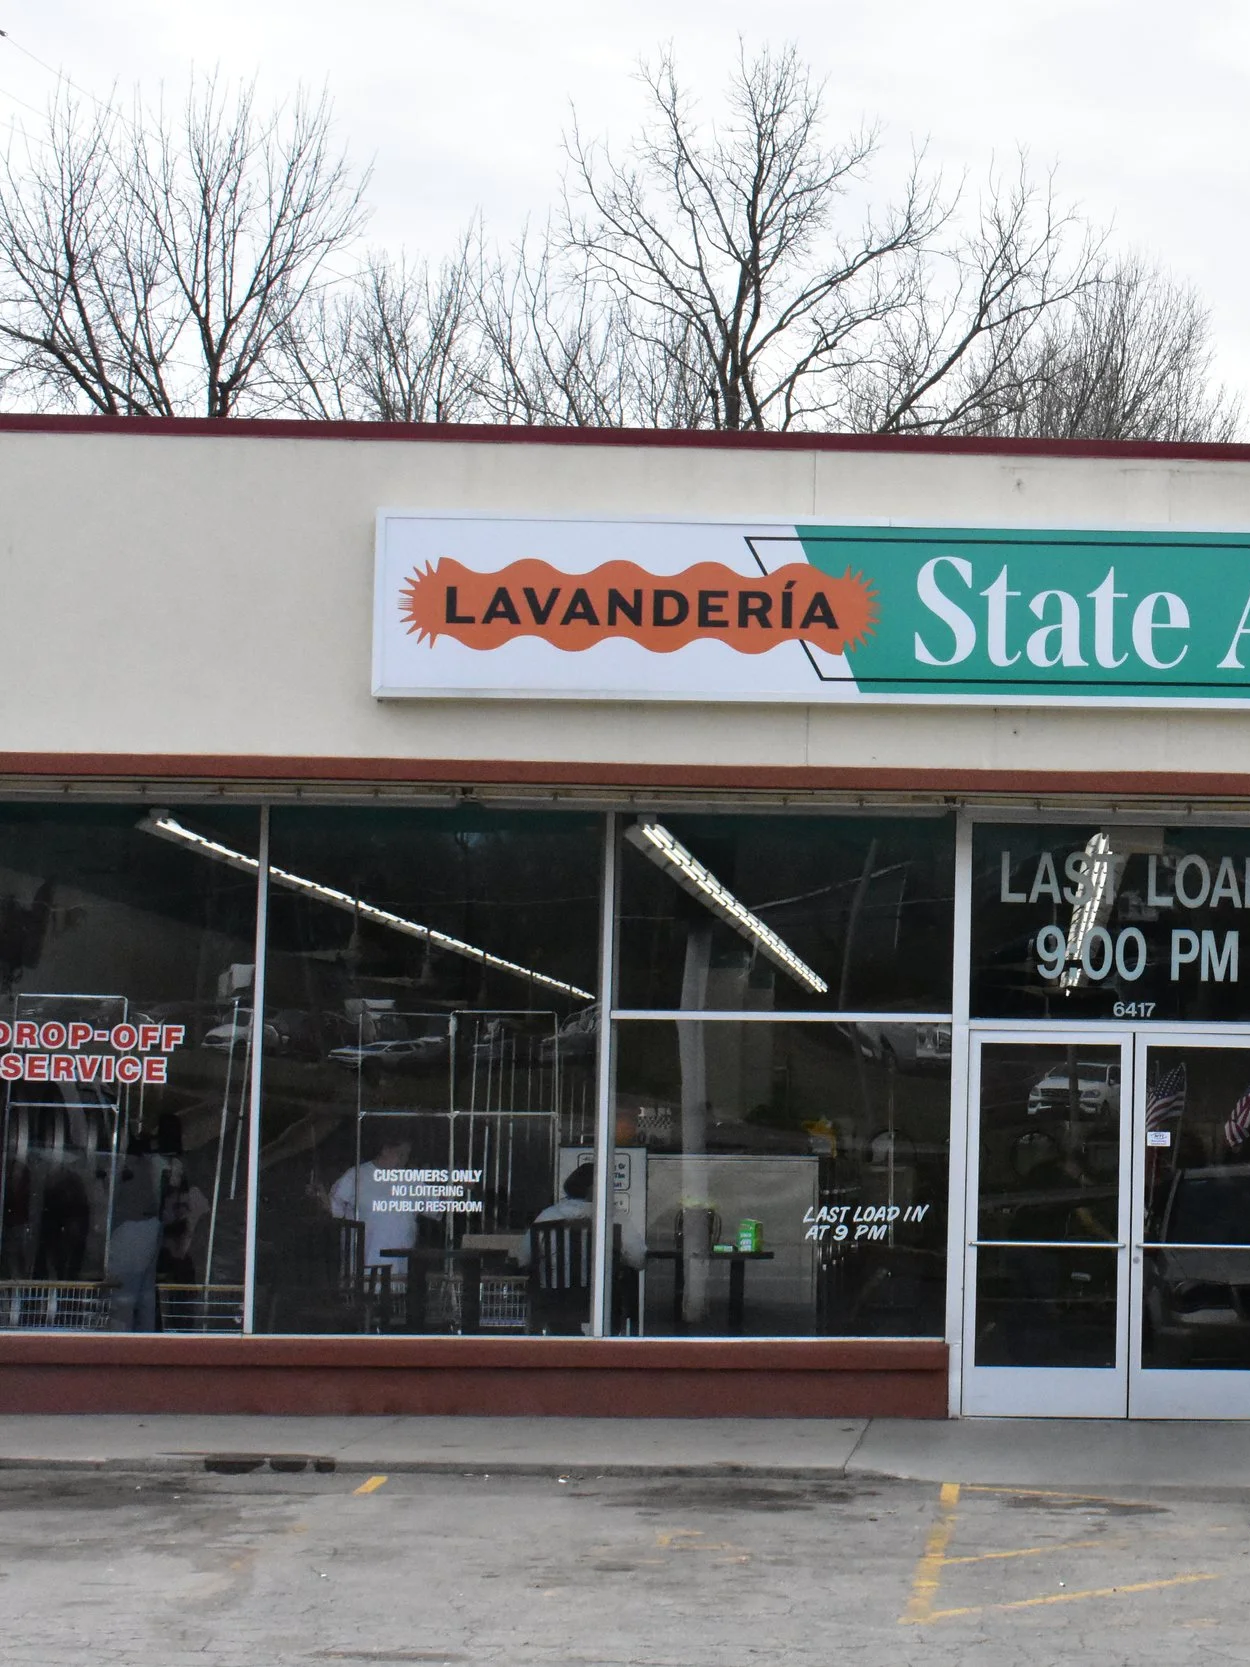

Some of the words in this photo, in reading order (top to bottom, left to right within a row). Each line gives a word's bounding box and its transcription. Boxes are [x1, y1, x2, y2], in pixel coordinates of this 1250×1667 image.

[444, 580, 840, 630] LAVANDERÍA
[915, 555, 1191, 670] State
[1000, 850, 1125, 906] LAST
[1170, 929, 1239, 983] PM
[1113, 1001, 1156, 1018] 6417
[0, 1053, 167, 1084] SERVICE
[373, 1169, 448, 1182] CUSTOMERS
[451, 1169, 482, 1182] ONLY
[391, 1185, 407, 1196] NO
[409, 1185, 464, 1197] LOITERING
[372, 1200, 387, 1212] NO
[389, 1201, 424, 1212] PUBLIC
[426, 1201, 482, 1212] RESTROOM
[802, 1206, 851, 1223] LAST
[853, 1206, 901, 1222] LOAD
[903, 1204, 930, 1222] IN
[804, 1225, 831, 1240] AT
[832, 1225, 849, 1240] 9
[854, 1225, 888, 1240] PM
